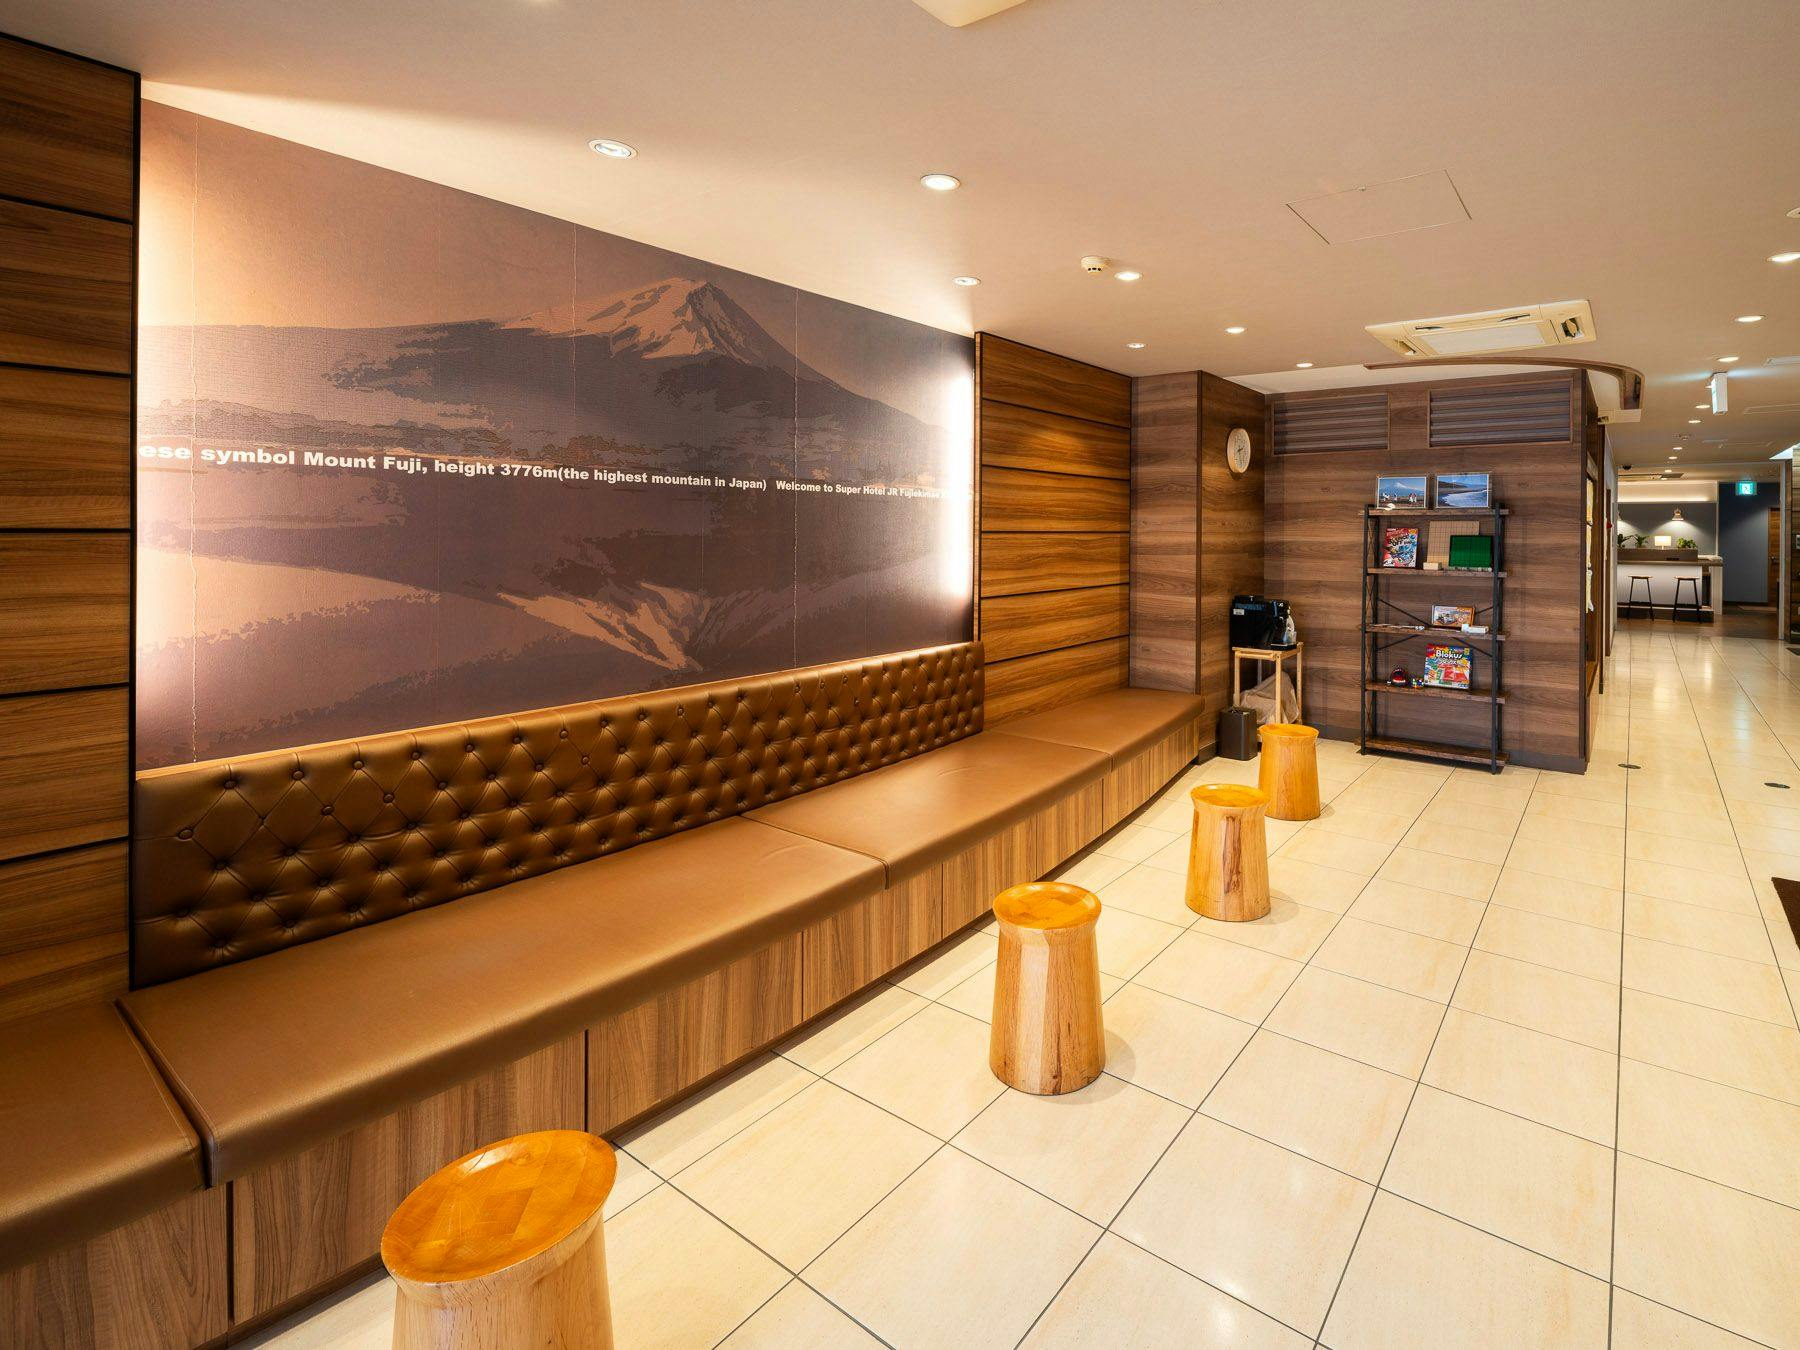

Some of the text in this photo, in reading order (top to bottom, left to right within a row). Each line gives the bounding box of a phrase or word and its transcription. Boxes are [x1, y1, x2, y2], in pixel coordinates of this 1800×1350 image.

[138, 445, 191, 459] ese
[200, 446, 295, 465] symbol
[304, 451, 376, 469] Mount
[383, 456, 428, 475] Fuji,
[434, 460, 495, 477] height
[594, 470, 648, 483] highest
[651, 474, 712, 486] mountain
[714, 476, 726, 486] in
[729, 477, 767, 491] Japan)
[776, 480, 821, 492] Welcome
[823, 483, 833, 492] to
[835, 484, 861, 495] Super
[863, 486, 885, 496] Hotel
[887, 487, 898, 497] JR
[1436, 649, 1463, 659] Blokus
